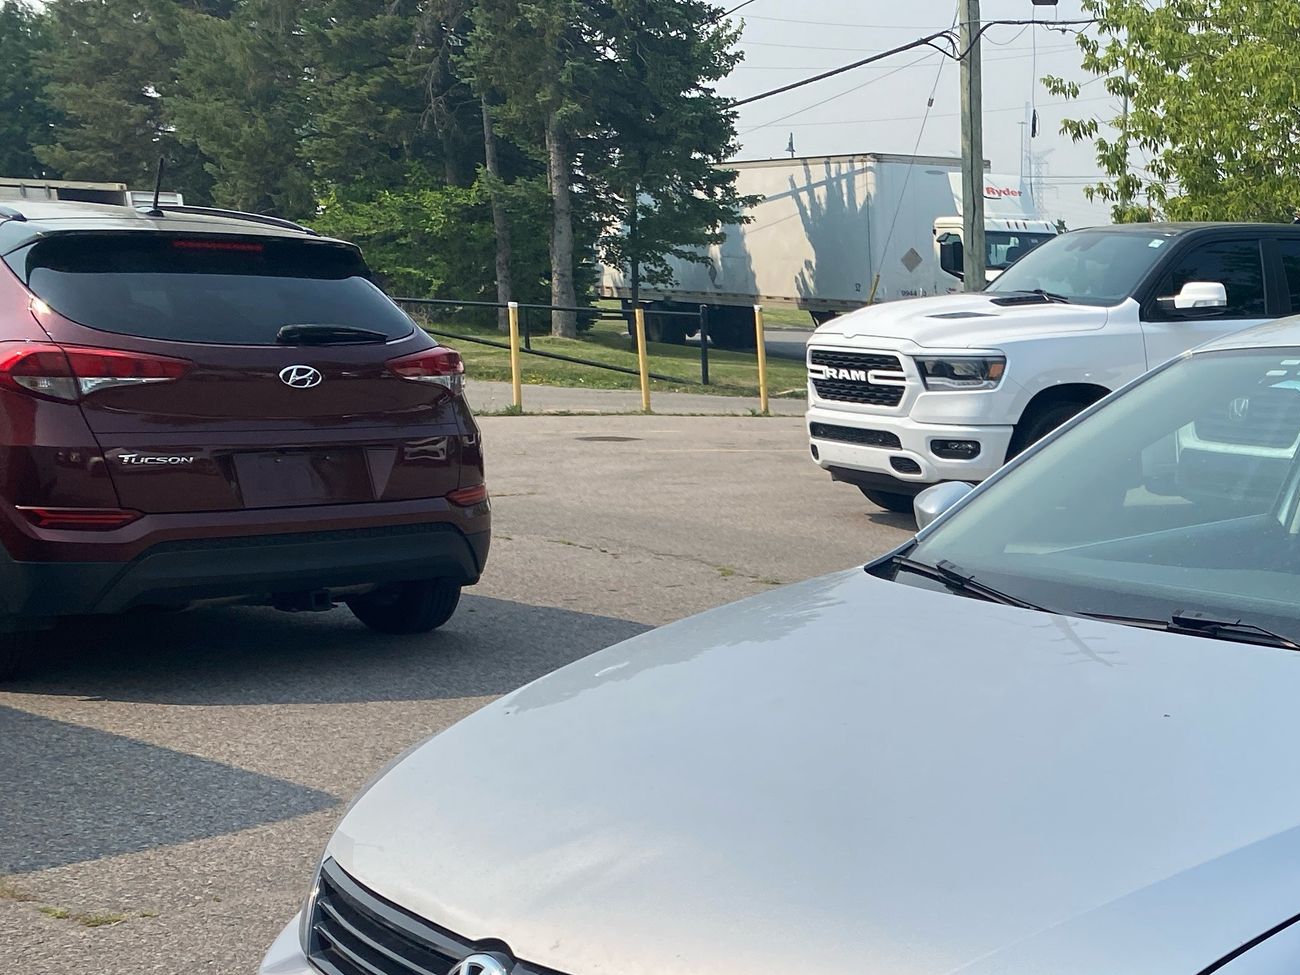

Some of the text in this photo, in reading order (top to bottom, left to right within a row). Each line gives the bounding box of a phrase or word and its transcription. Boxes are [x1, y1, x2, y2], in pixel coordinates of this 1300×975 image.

[985, 187, 1022, 196] Ryder
[824, 368, 867, 382] RAM
[118, 453, 194, 465] TUCSON
